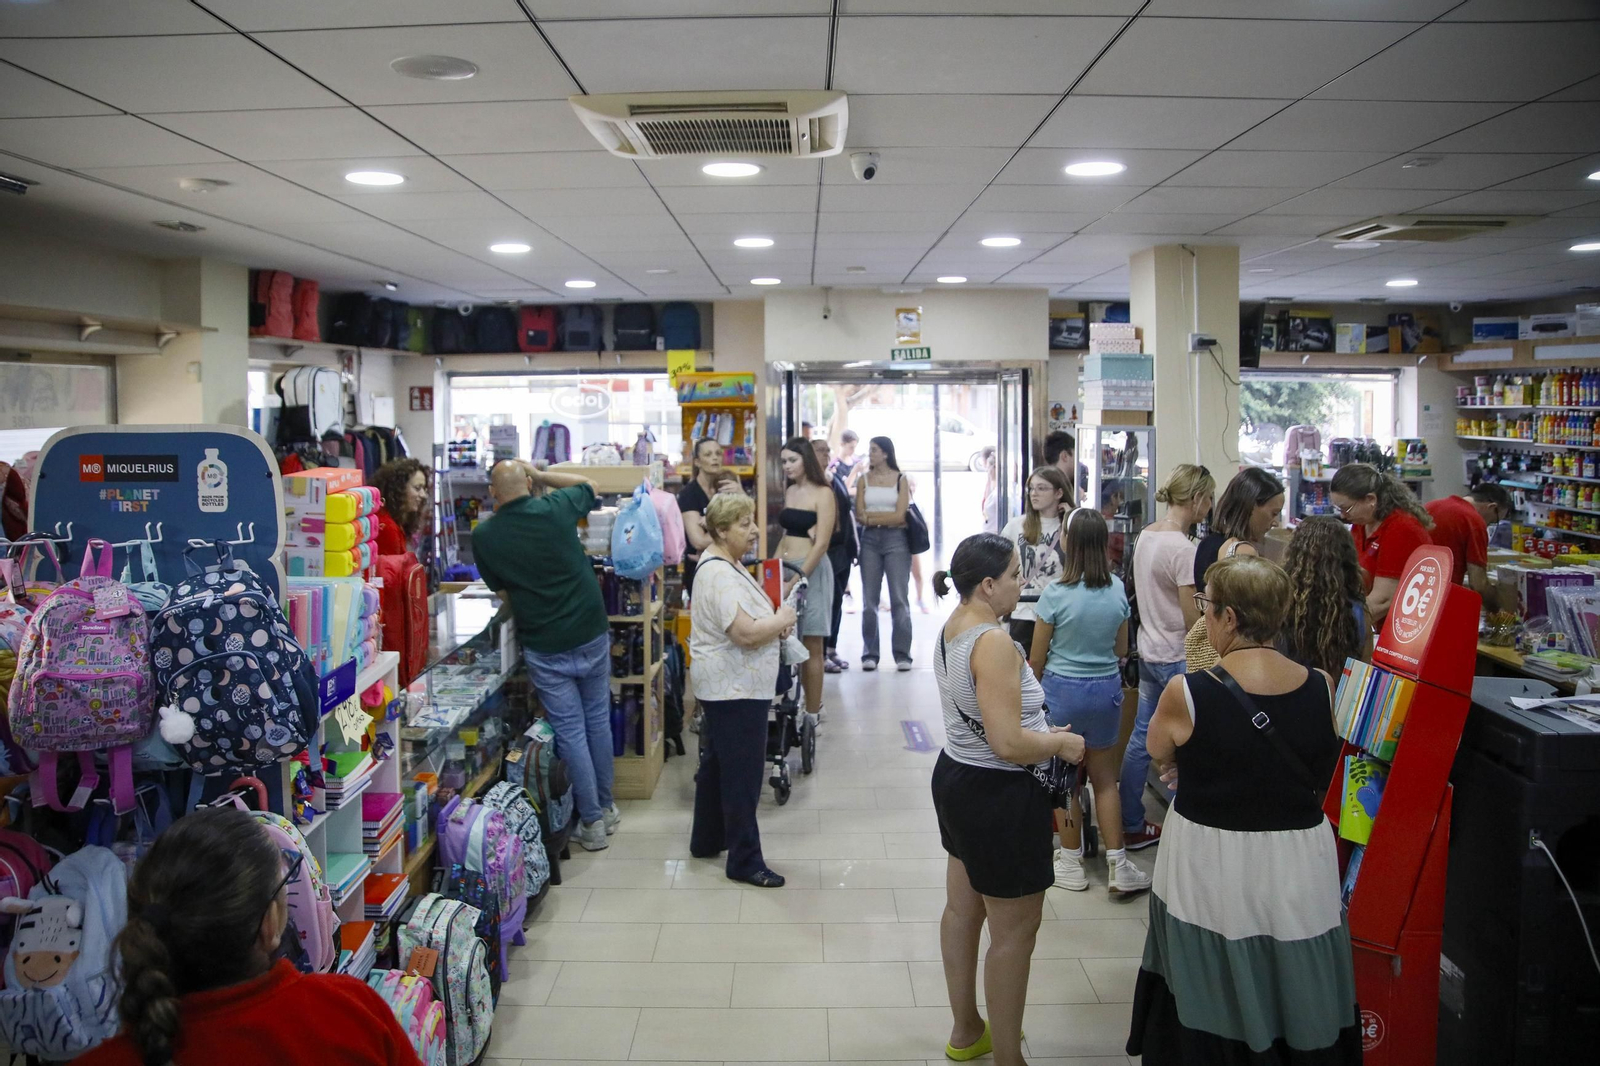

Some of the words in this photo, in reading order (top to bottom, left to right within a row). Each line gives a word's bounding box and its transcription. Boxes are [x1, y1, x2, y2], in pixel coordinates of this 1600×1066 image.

[893, 348, 929, 359] SALIDA
[107, 463, 174, 474] MIQUELRIUS
[99, 488, 160, 501] #PLANET
[111, 501, 149, 513] FIRST
[1427, 576, 1436, 586] 90
